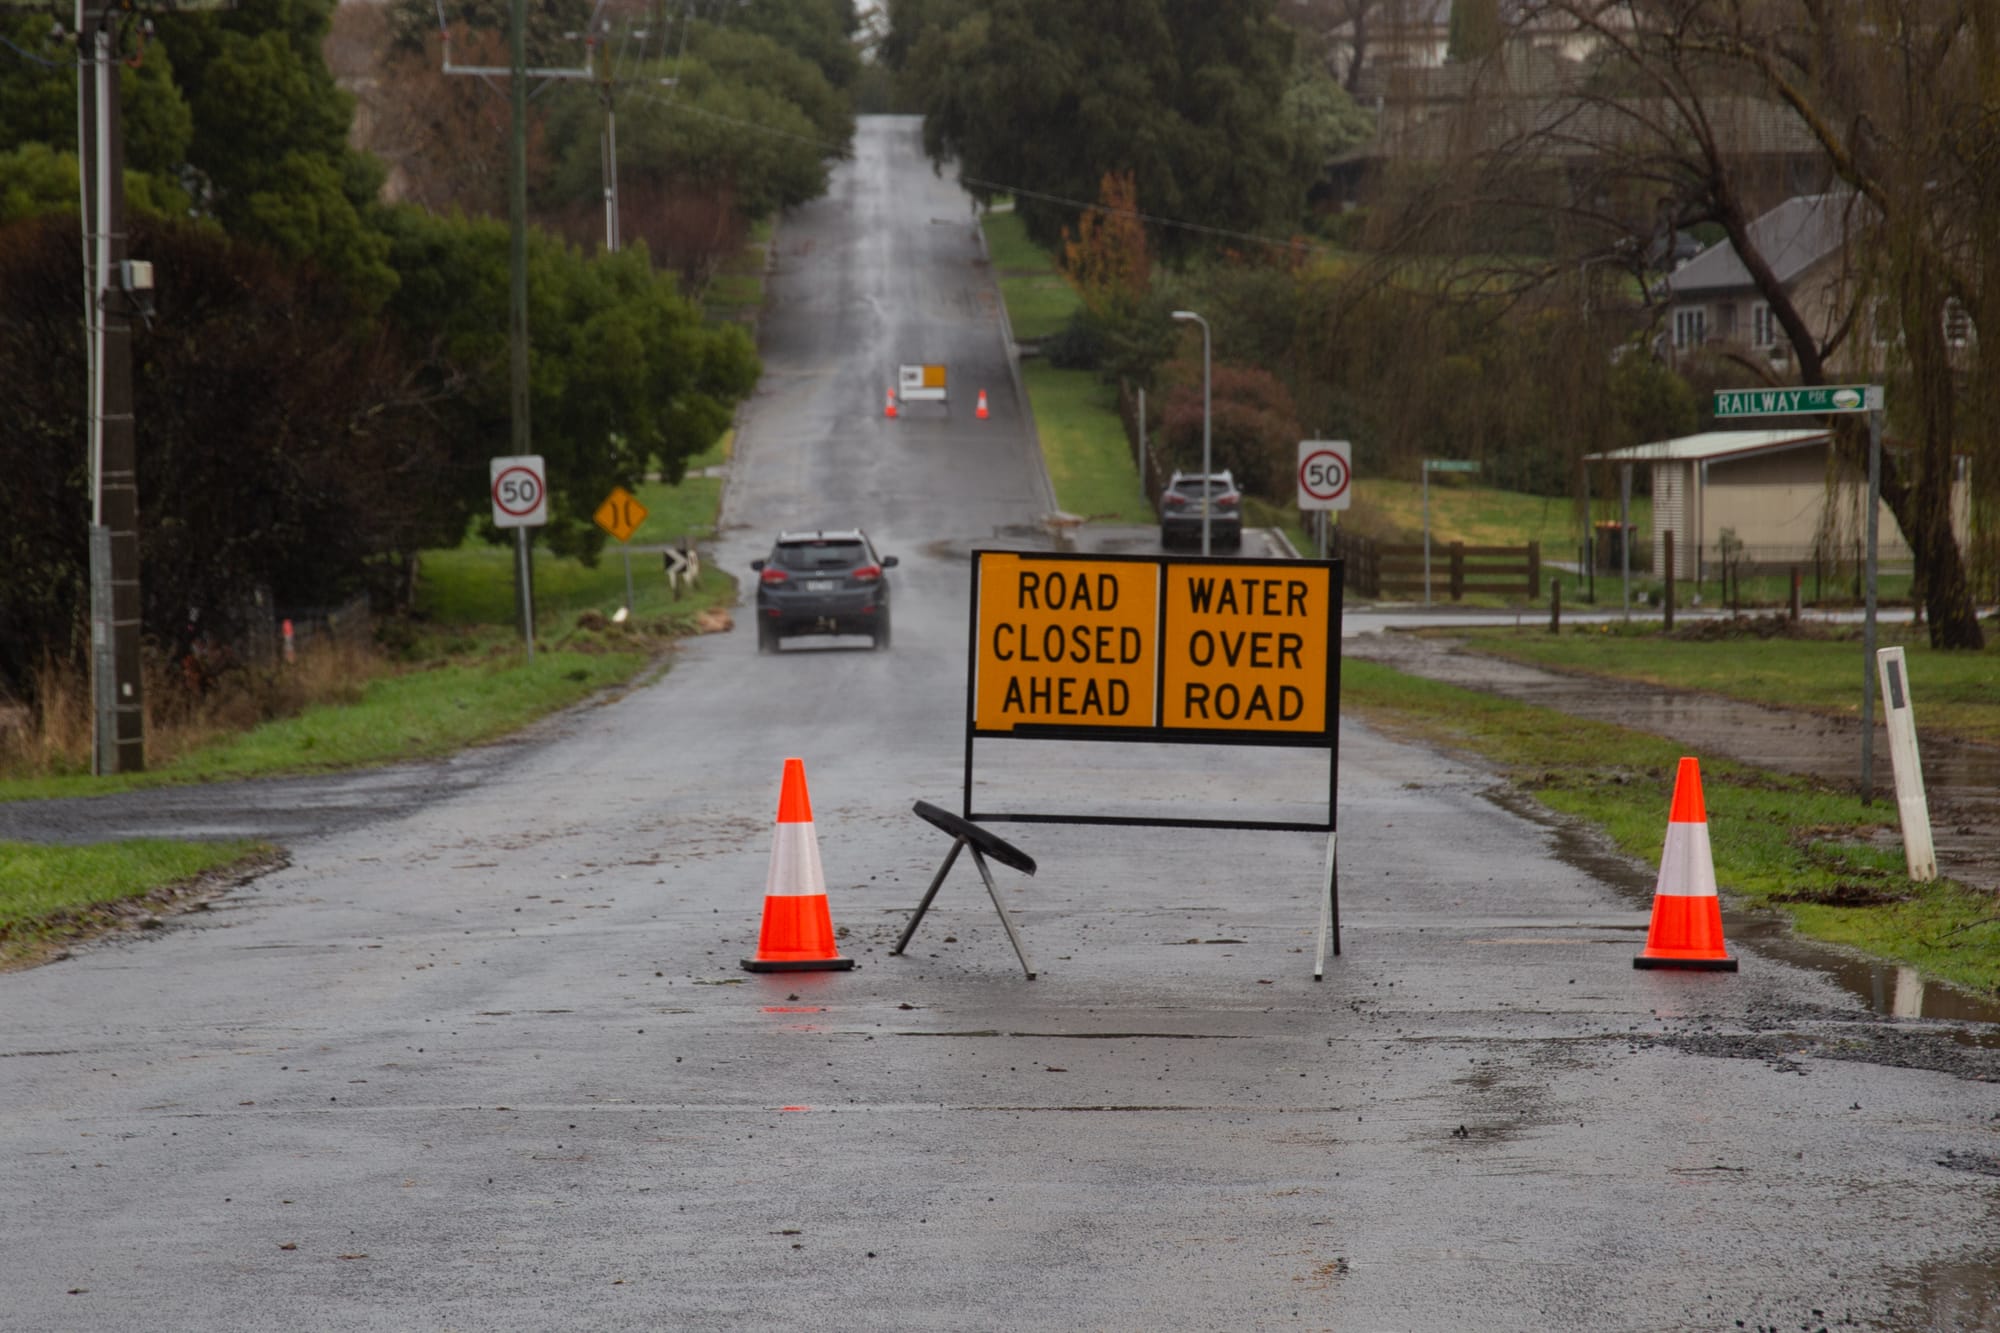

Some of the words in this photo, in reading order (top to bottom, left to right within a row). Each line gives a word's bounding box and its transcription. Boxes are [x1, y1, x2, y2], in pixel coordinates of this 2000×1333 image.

[1718, 393, 1801, 413] RAILWAY
[503, 480, 535, 503] 50
[1310, 464, 1341, 487] 50
[1018, 571, 1119, 611] ROAD
[1188, 577, 1308, 617] WATER
[993, 623, 1142, 664] CLOSED
[1189, 630, 1304, 669] OVER
[1002, 676, 1130, 716] AHEAD
[1185, 682, 1304, 721] ROAD
